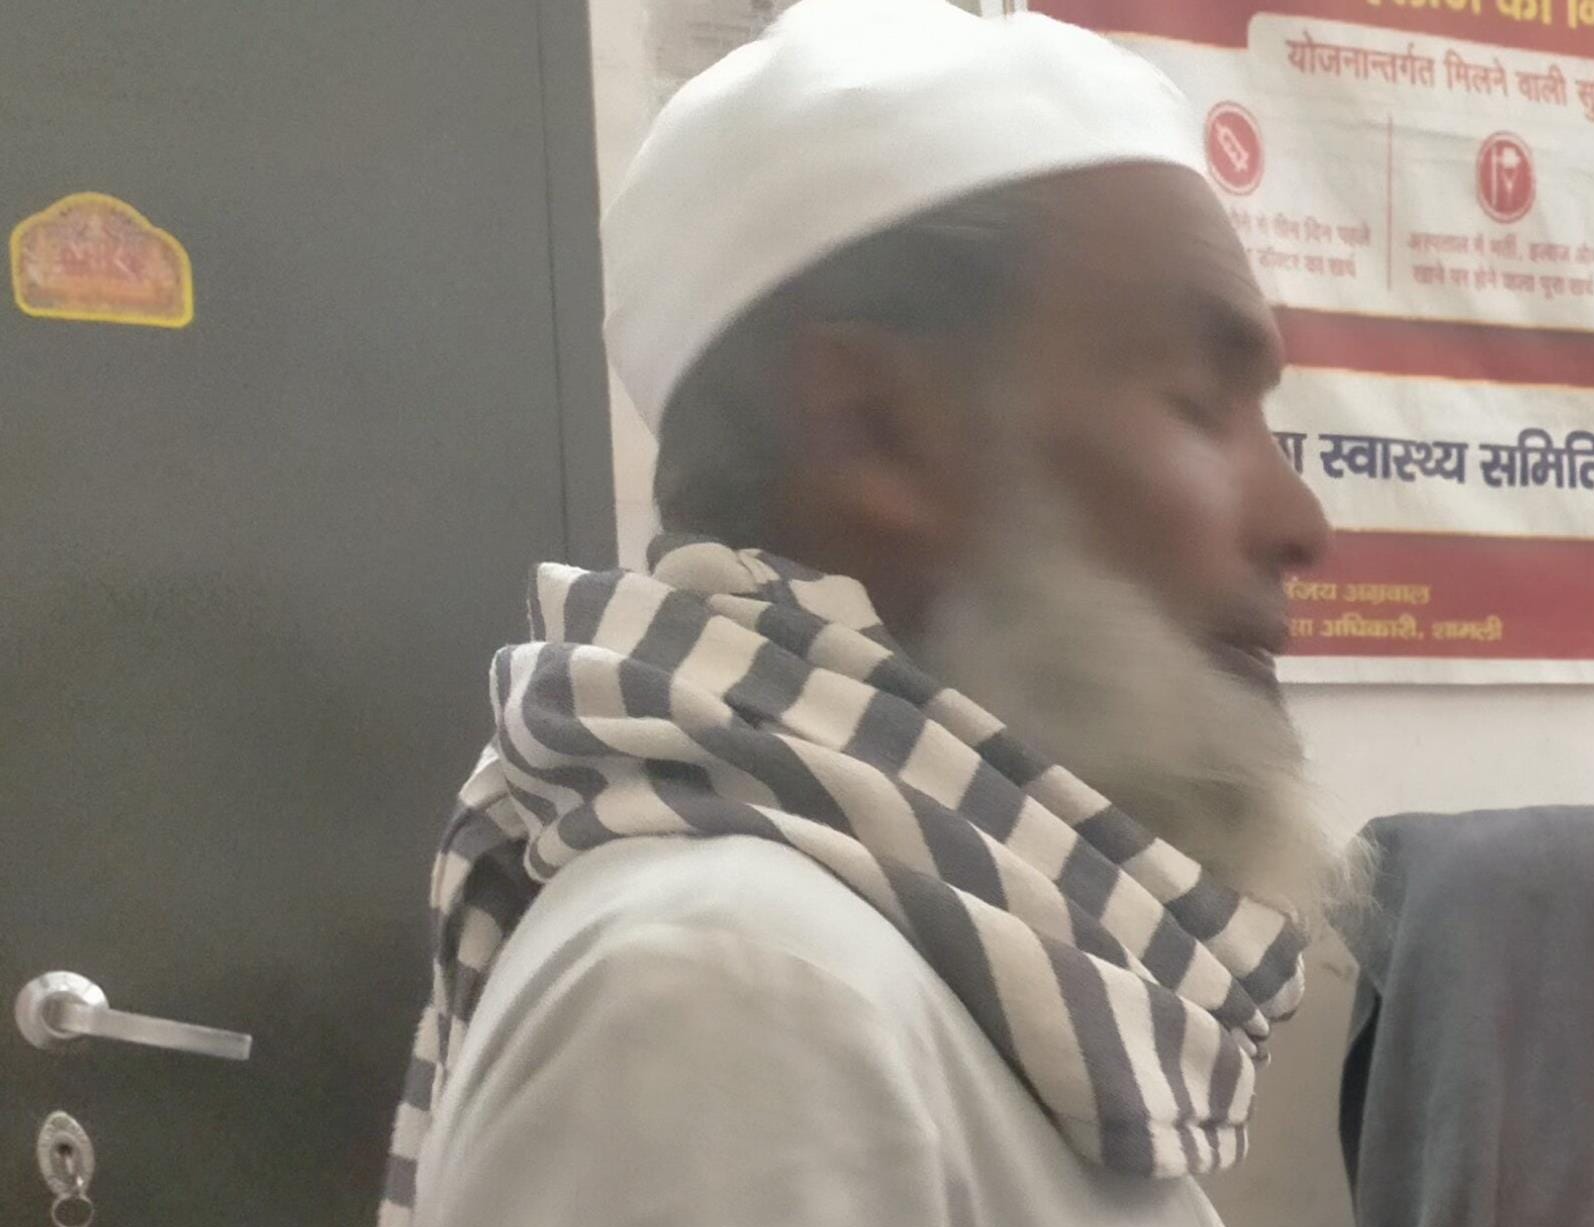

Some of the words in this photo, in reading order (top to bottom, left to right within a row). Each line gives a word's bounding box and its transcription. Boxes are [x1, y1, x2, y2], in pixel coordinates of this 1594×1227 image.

[1284, 29, 1435, 87] योजनान्तर्गत
[1443, 48, 1510, 97] मिलने
[1515, 63, 1567, 107] वाली
[1318, 433, 1469, 484] स्वास्थ्य
[1432, 614, 1504, 642] शामली
